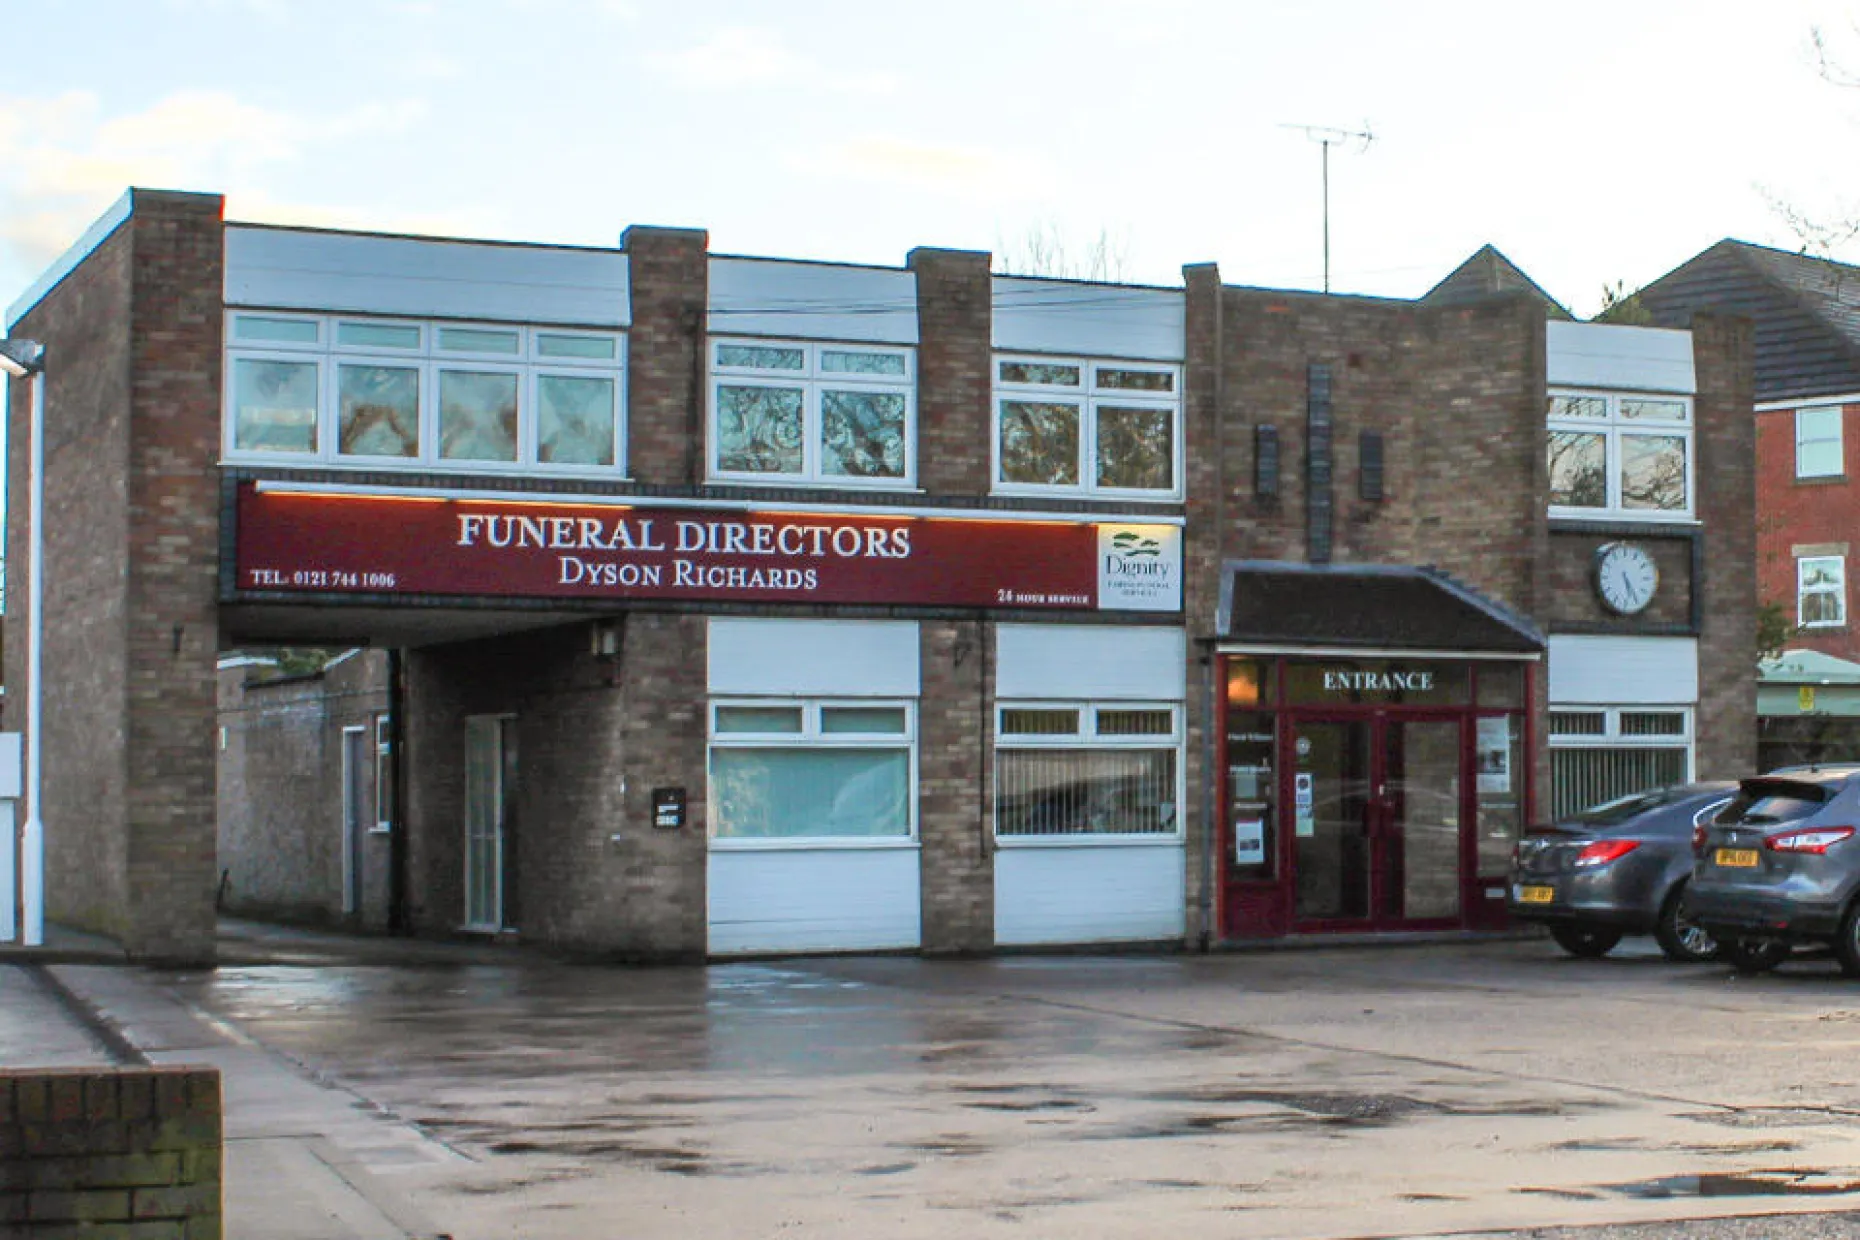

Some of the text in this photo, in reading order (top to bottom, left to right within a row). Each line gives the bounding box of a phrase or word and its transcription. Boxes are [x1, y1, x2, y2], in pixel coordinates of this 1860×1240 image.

[457, 513, 911, 558] FUNERAL DIRECTORS
[294, 570, 328, 586] 0121
[332, 571, 358, 588] 744
[362, 572, 396, 588] 1006
[558, 556, 817, 589] DYSON RICHARDS
[1106, 555, 1170, 580] Dignity
[1323, 671, 1434, 692] ENTRANCE
